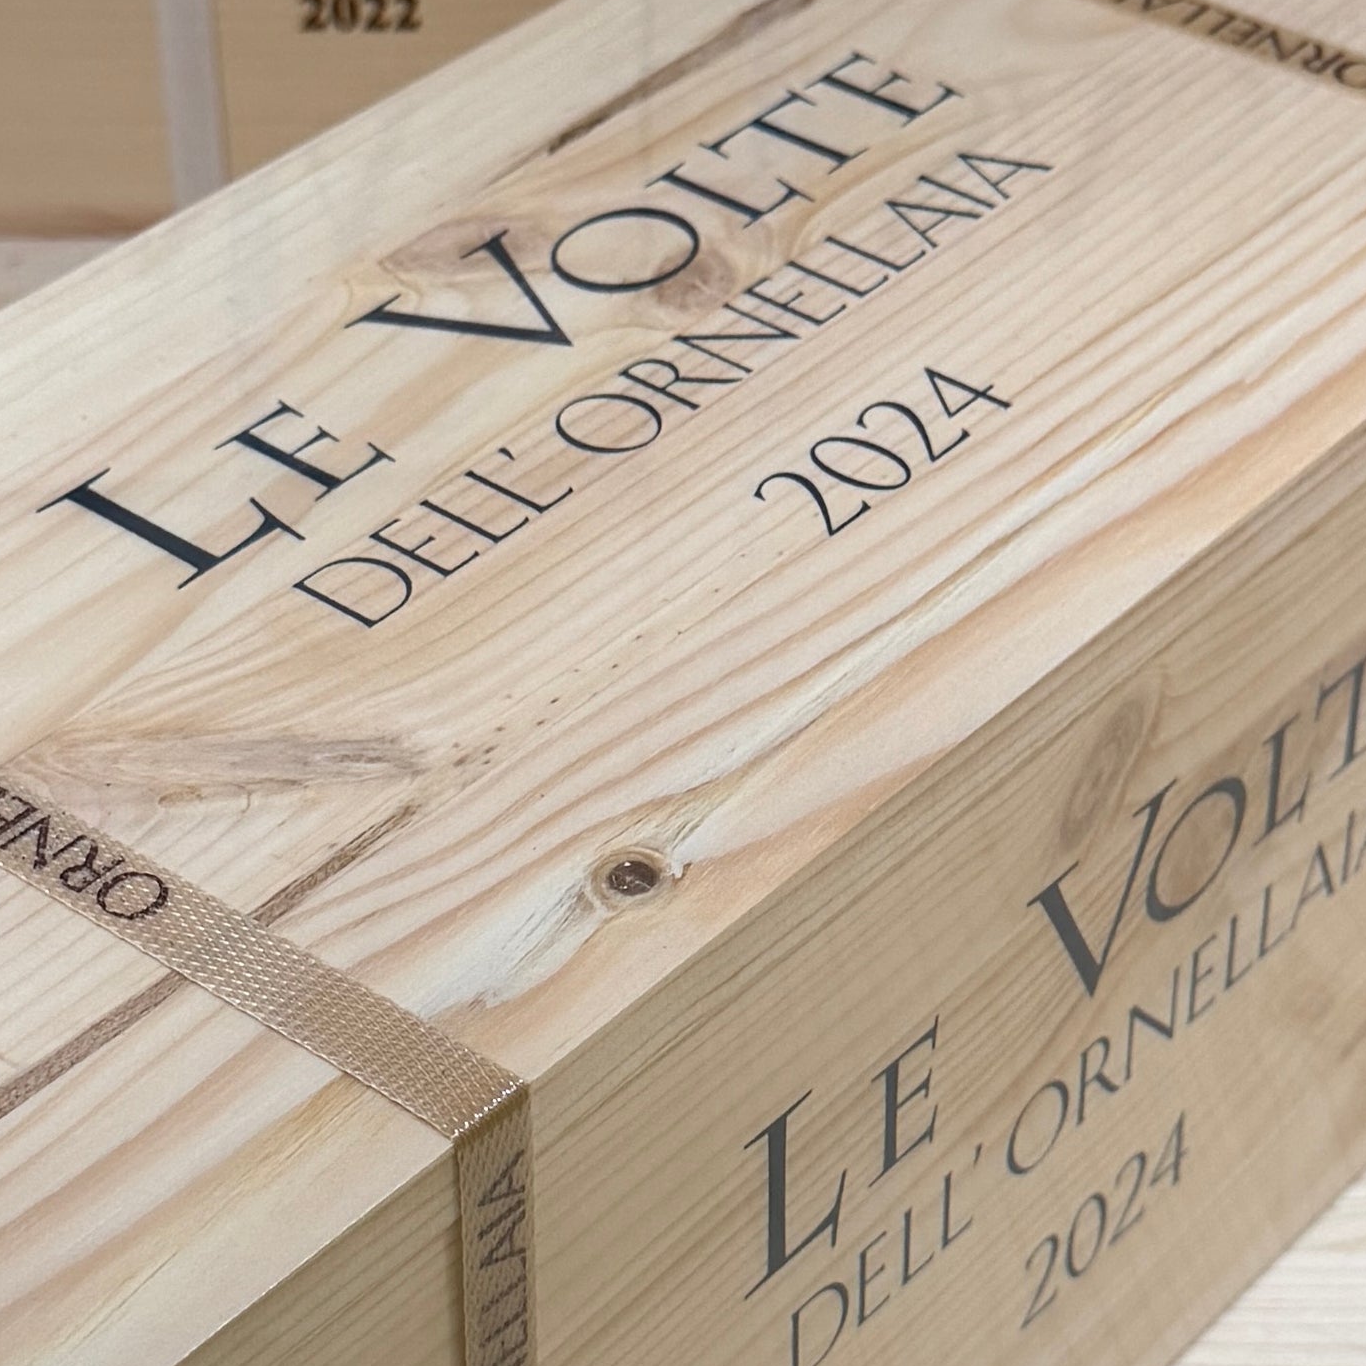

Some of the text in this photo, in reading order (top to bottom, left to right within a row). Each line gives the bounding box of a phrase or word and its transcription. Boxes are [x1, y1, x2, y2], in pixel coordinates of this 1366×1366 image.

[36, 51, 964, 590] LE VOLTE
[753, 365, 1013, 538] 2024
[743, 1015, 940, 1299] LE
[1019, 1109, 1191, 1331] 2024
